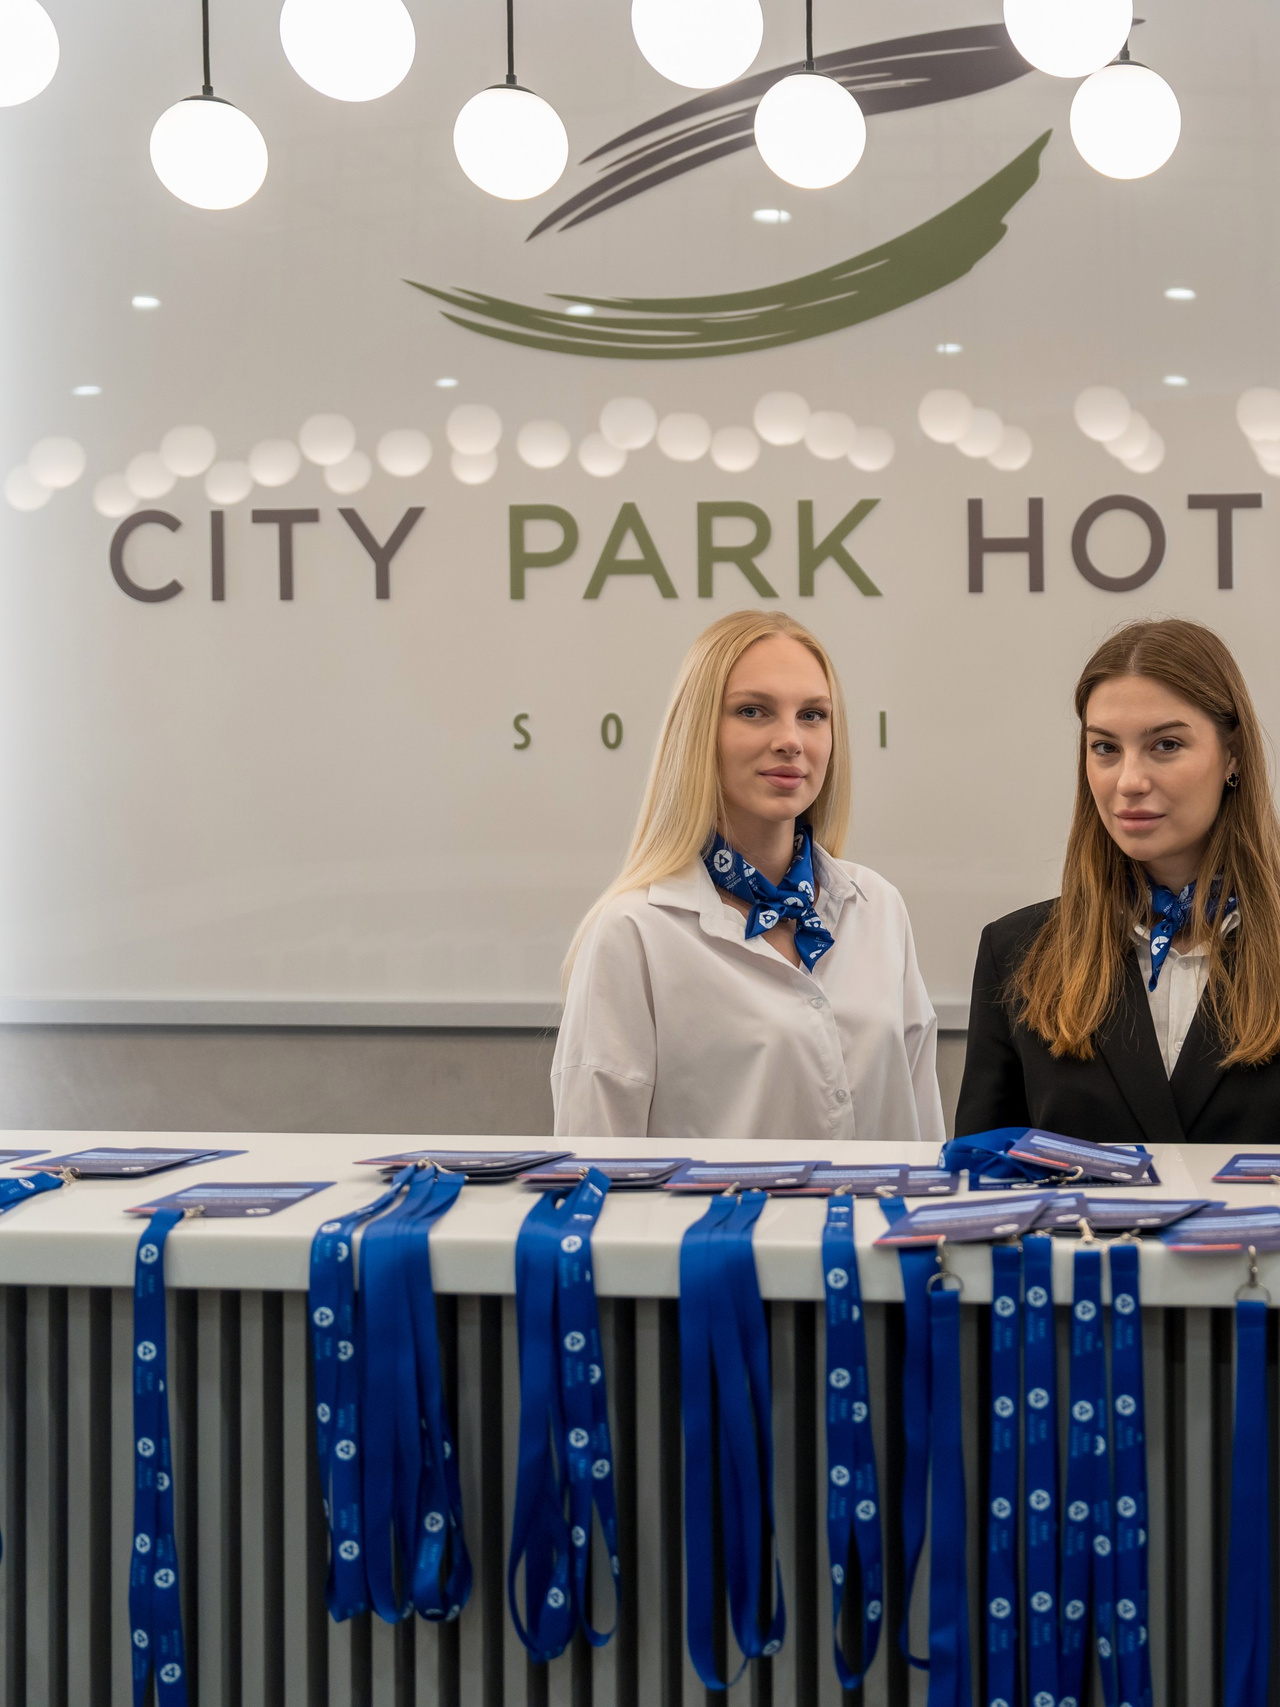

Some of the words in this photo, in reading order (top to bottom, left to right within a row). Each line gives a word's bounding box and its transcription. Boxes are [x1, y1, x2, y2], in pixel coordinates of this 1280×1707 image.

[109, 505, 426, 603] CITY
[508, 499, 883, 601] PARK
[512, 711, 888, 751] SOI
